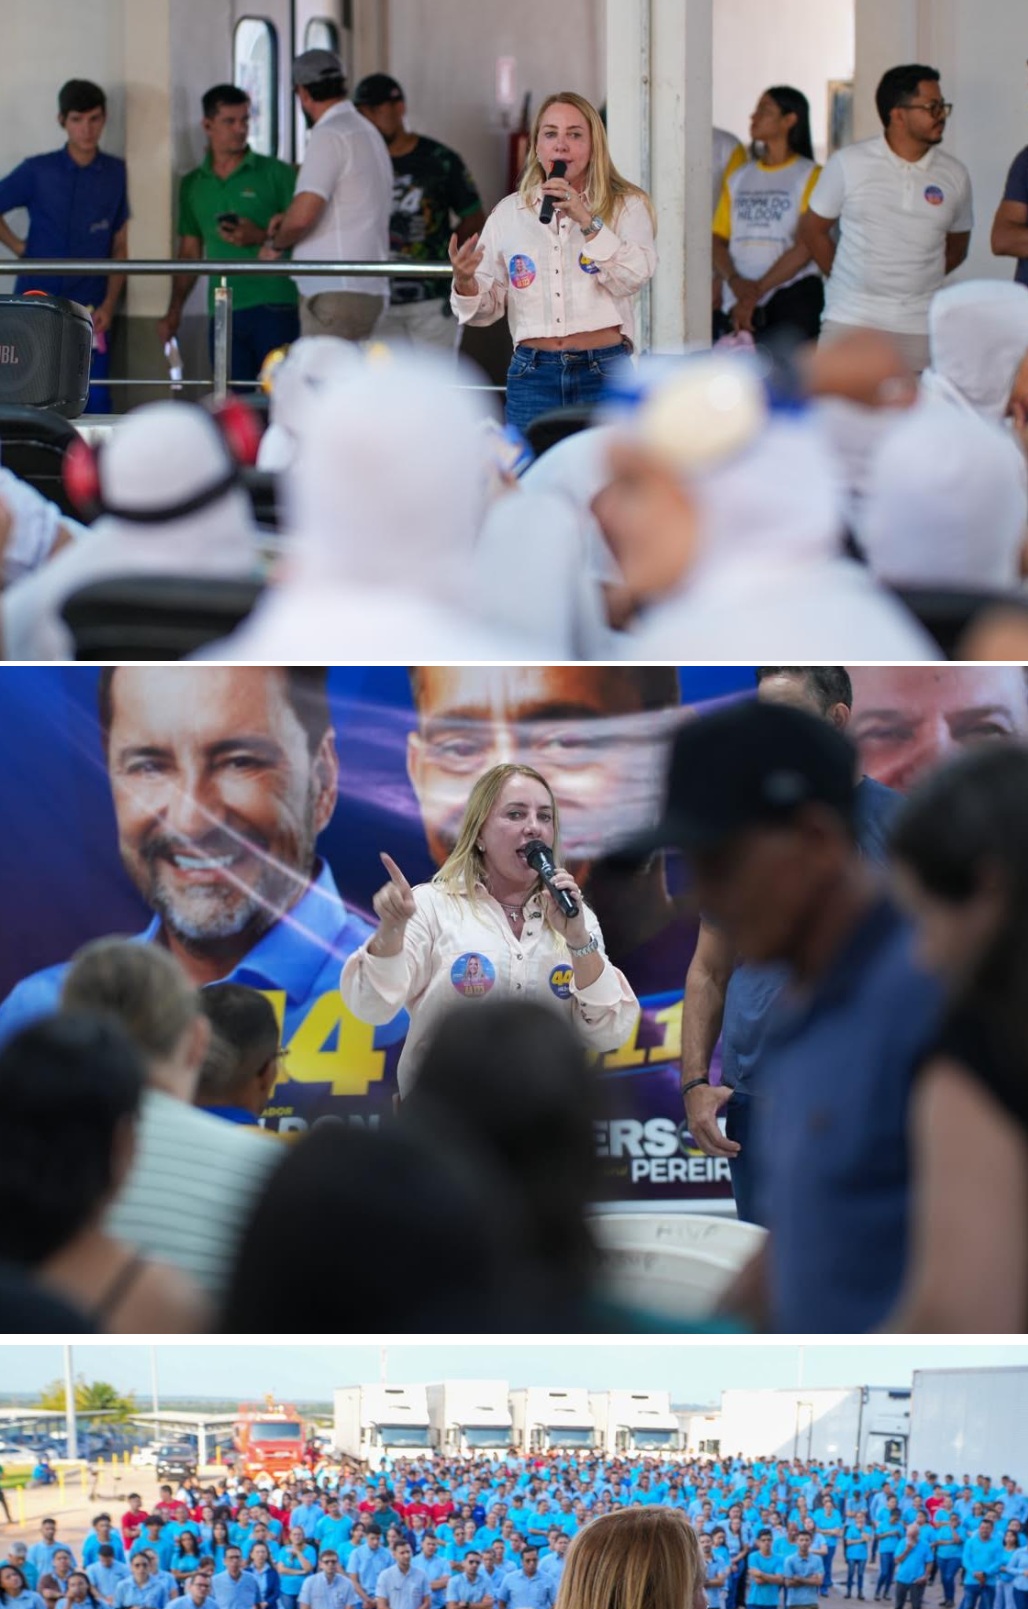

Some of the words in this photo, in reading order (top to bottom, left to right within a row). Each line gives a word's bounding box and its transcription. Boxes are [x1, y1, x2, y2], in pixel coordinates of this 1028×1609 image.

[0, 345, 19, 364] BL
[258, 988, 386, 1096] 4
[262, 1106, 294, 1116] ADOR
[632, 1157, 732, 1183] PEREIR
